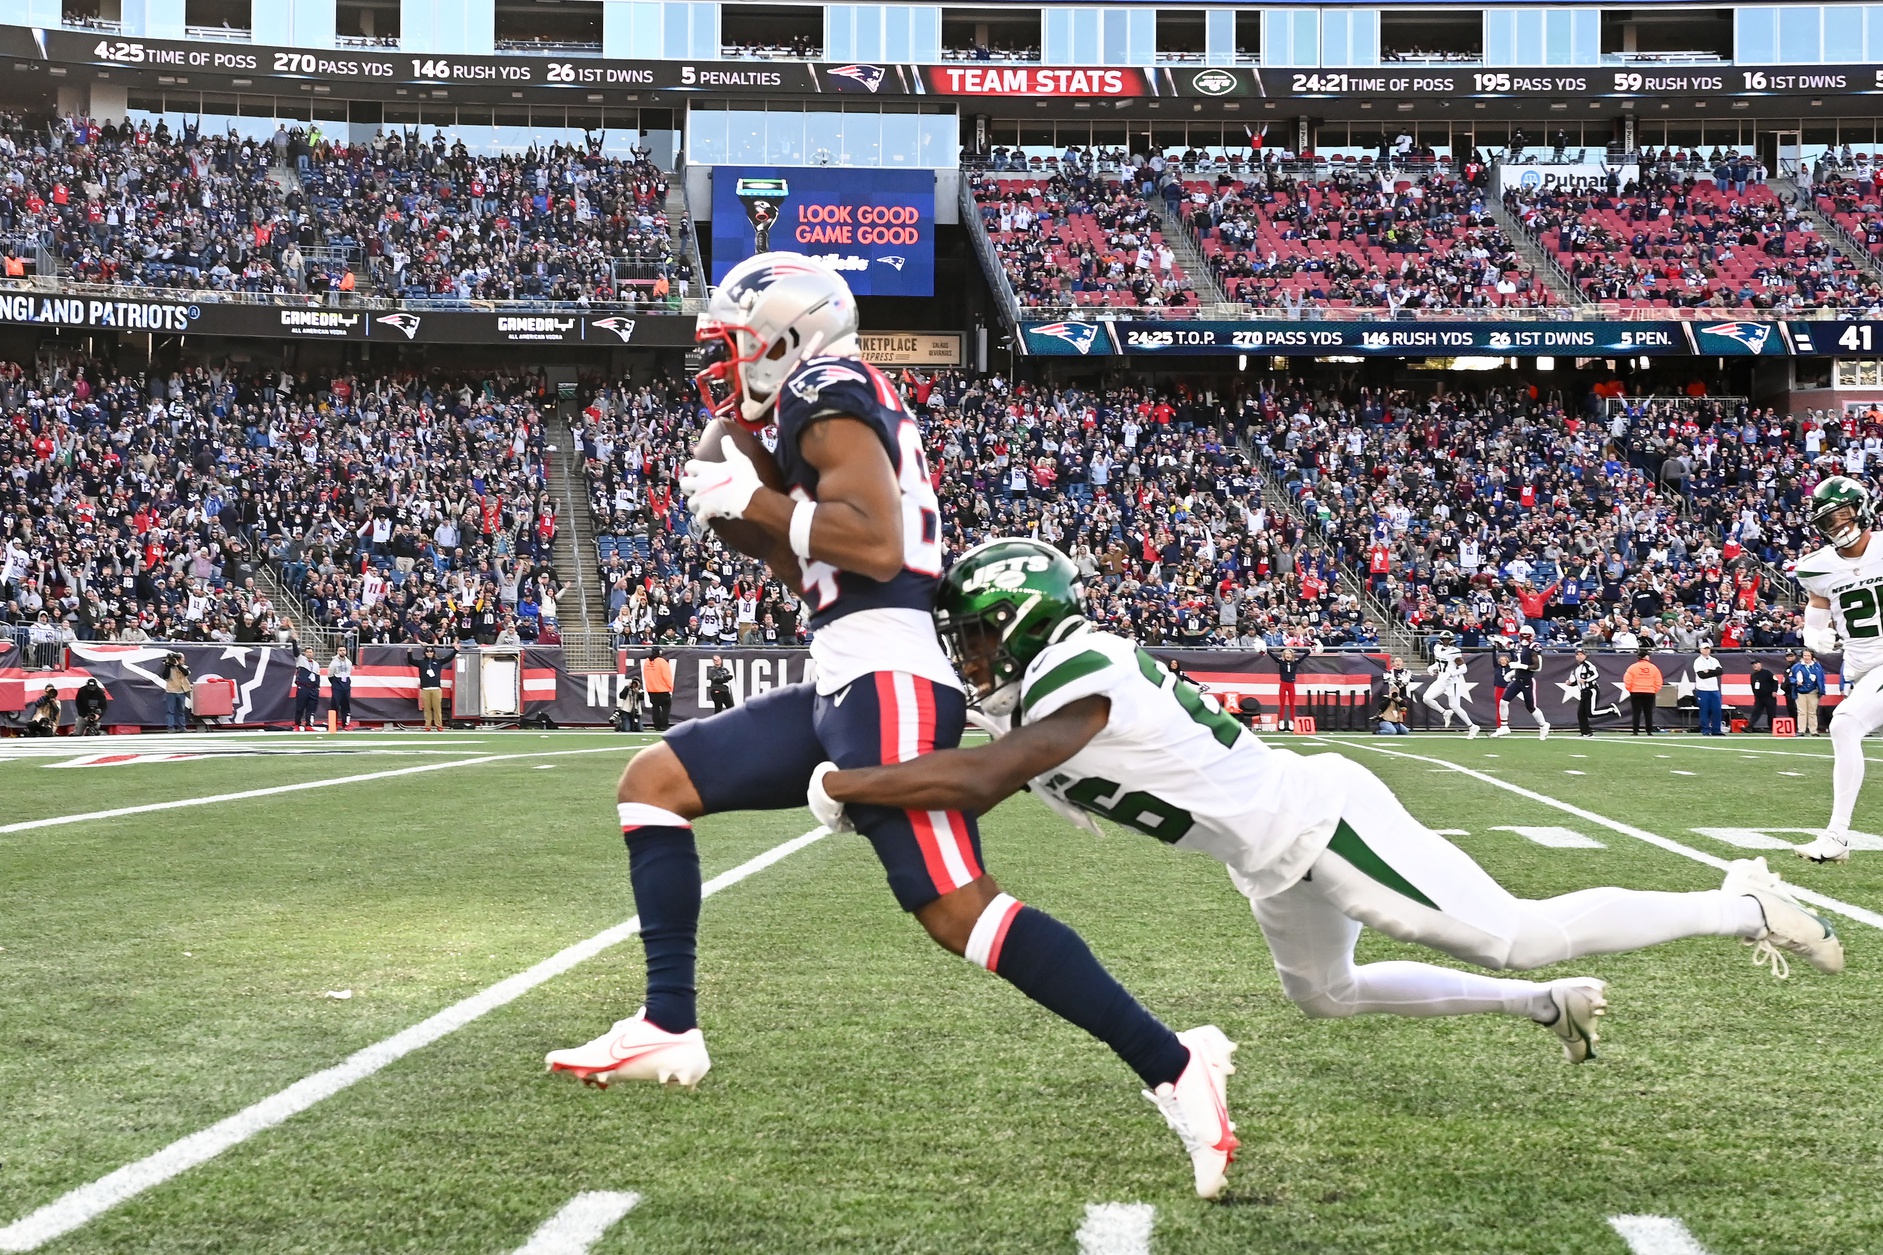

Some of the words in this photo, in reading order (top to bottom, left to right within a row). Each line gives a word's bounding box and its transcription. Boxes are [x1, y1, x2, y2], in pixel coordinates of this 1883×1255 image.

[94, 41, 144, 62] 4:25
[146, 49, 185, 65] TIME
[189, 51, 210, 66] OF
[215, 53, 257, 69] POSS
[274, 52, 316, 73] 270
[319, 60, 358, 75] PASS
[362, 62, 394, 77] YDS
[411, 59, 451, 78] 146
[453, 65, 495, 79] RUSH
[499, 66, 531, 80] YDS
[547, 63, 575, 82] 26
[578, 68, 603, 82] 1ST
[607, 69, 654, 83] DWNS
[681, 66, 696, 85] 5
[700, 71, 781, 86] PENALTIES
[947, 69, 1027, 92] TEAM
[1036, 70, 1124, 93] STATS
[1292, 73, 1348, 92] 24:21
[1350, 78, 1386, 92] TIME
[1389, 78, 1410, 92] OF
[1413, 78, 1454, 92] POSS
[1473, 73, 1511, 92] 195
[1514, 78, 1551, 91] PASS
[1555, 78, 1587, 91] YDS
[1613, 73, 1643, 91] 59
[1645, 77, 1688, 90] RUSH
[1691, 76, 1723, 90] YDS
[1742, 72, 1767, 90] 16
[1770, 76, 1796, 89] 1ST
[1799, 75, 1847, 89] DWNS
[799, 204, 853, 224] LOOK
[857, 206, 919, 225] GOOD
[795, 225, 852, 244] GAME
[857, 226, 919, 245] GOOD
[1128, 331, 1174, 345] 24:25
[1176, 331, 1216, 345] T.O.P.
[1232, 331, 1263, 345] 270
[1266, 331, 1307, 345] PASS
[1310, 331, 1343, 345] YDS
[1362, 332, 1389, 345] 146
[1392, 332, 1436, 345] RUSH
[1440, 332, 1473, 345] YDS
[1489, 332, 1511, 345] 26
[1514, 333, 1541, 345] 1ST
[1545, 333, 1594, 345] DWNS
[1620, 332, 1633, 345] 5
[1636, 332, 1672, 345] PEN.
[1838, 326, 1872, 351] 41
[962, 555, 1050, 592] JETS
[1832, 582, 1856, 594] NEW
[1298, 719, 1312, 732] 10
[1776, 720, 1791, 733] 20
